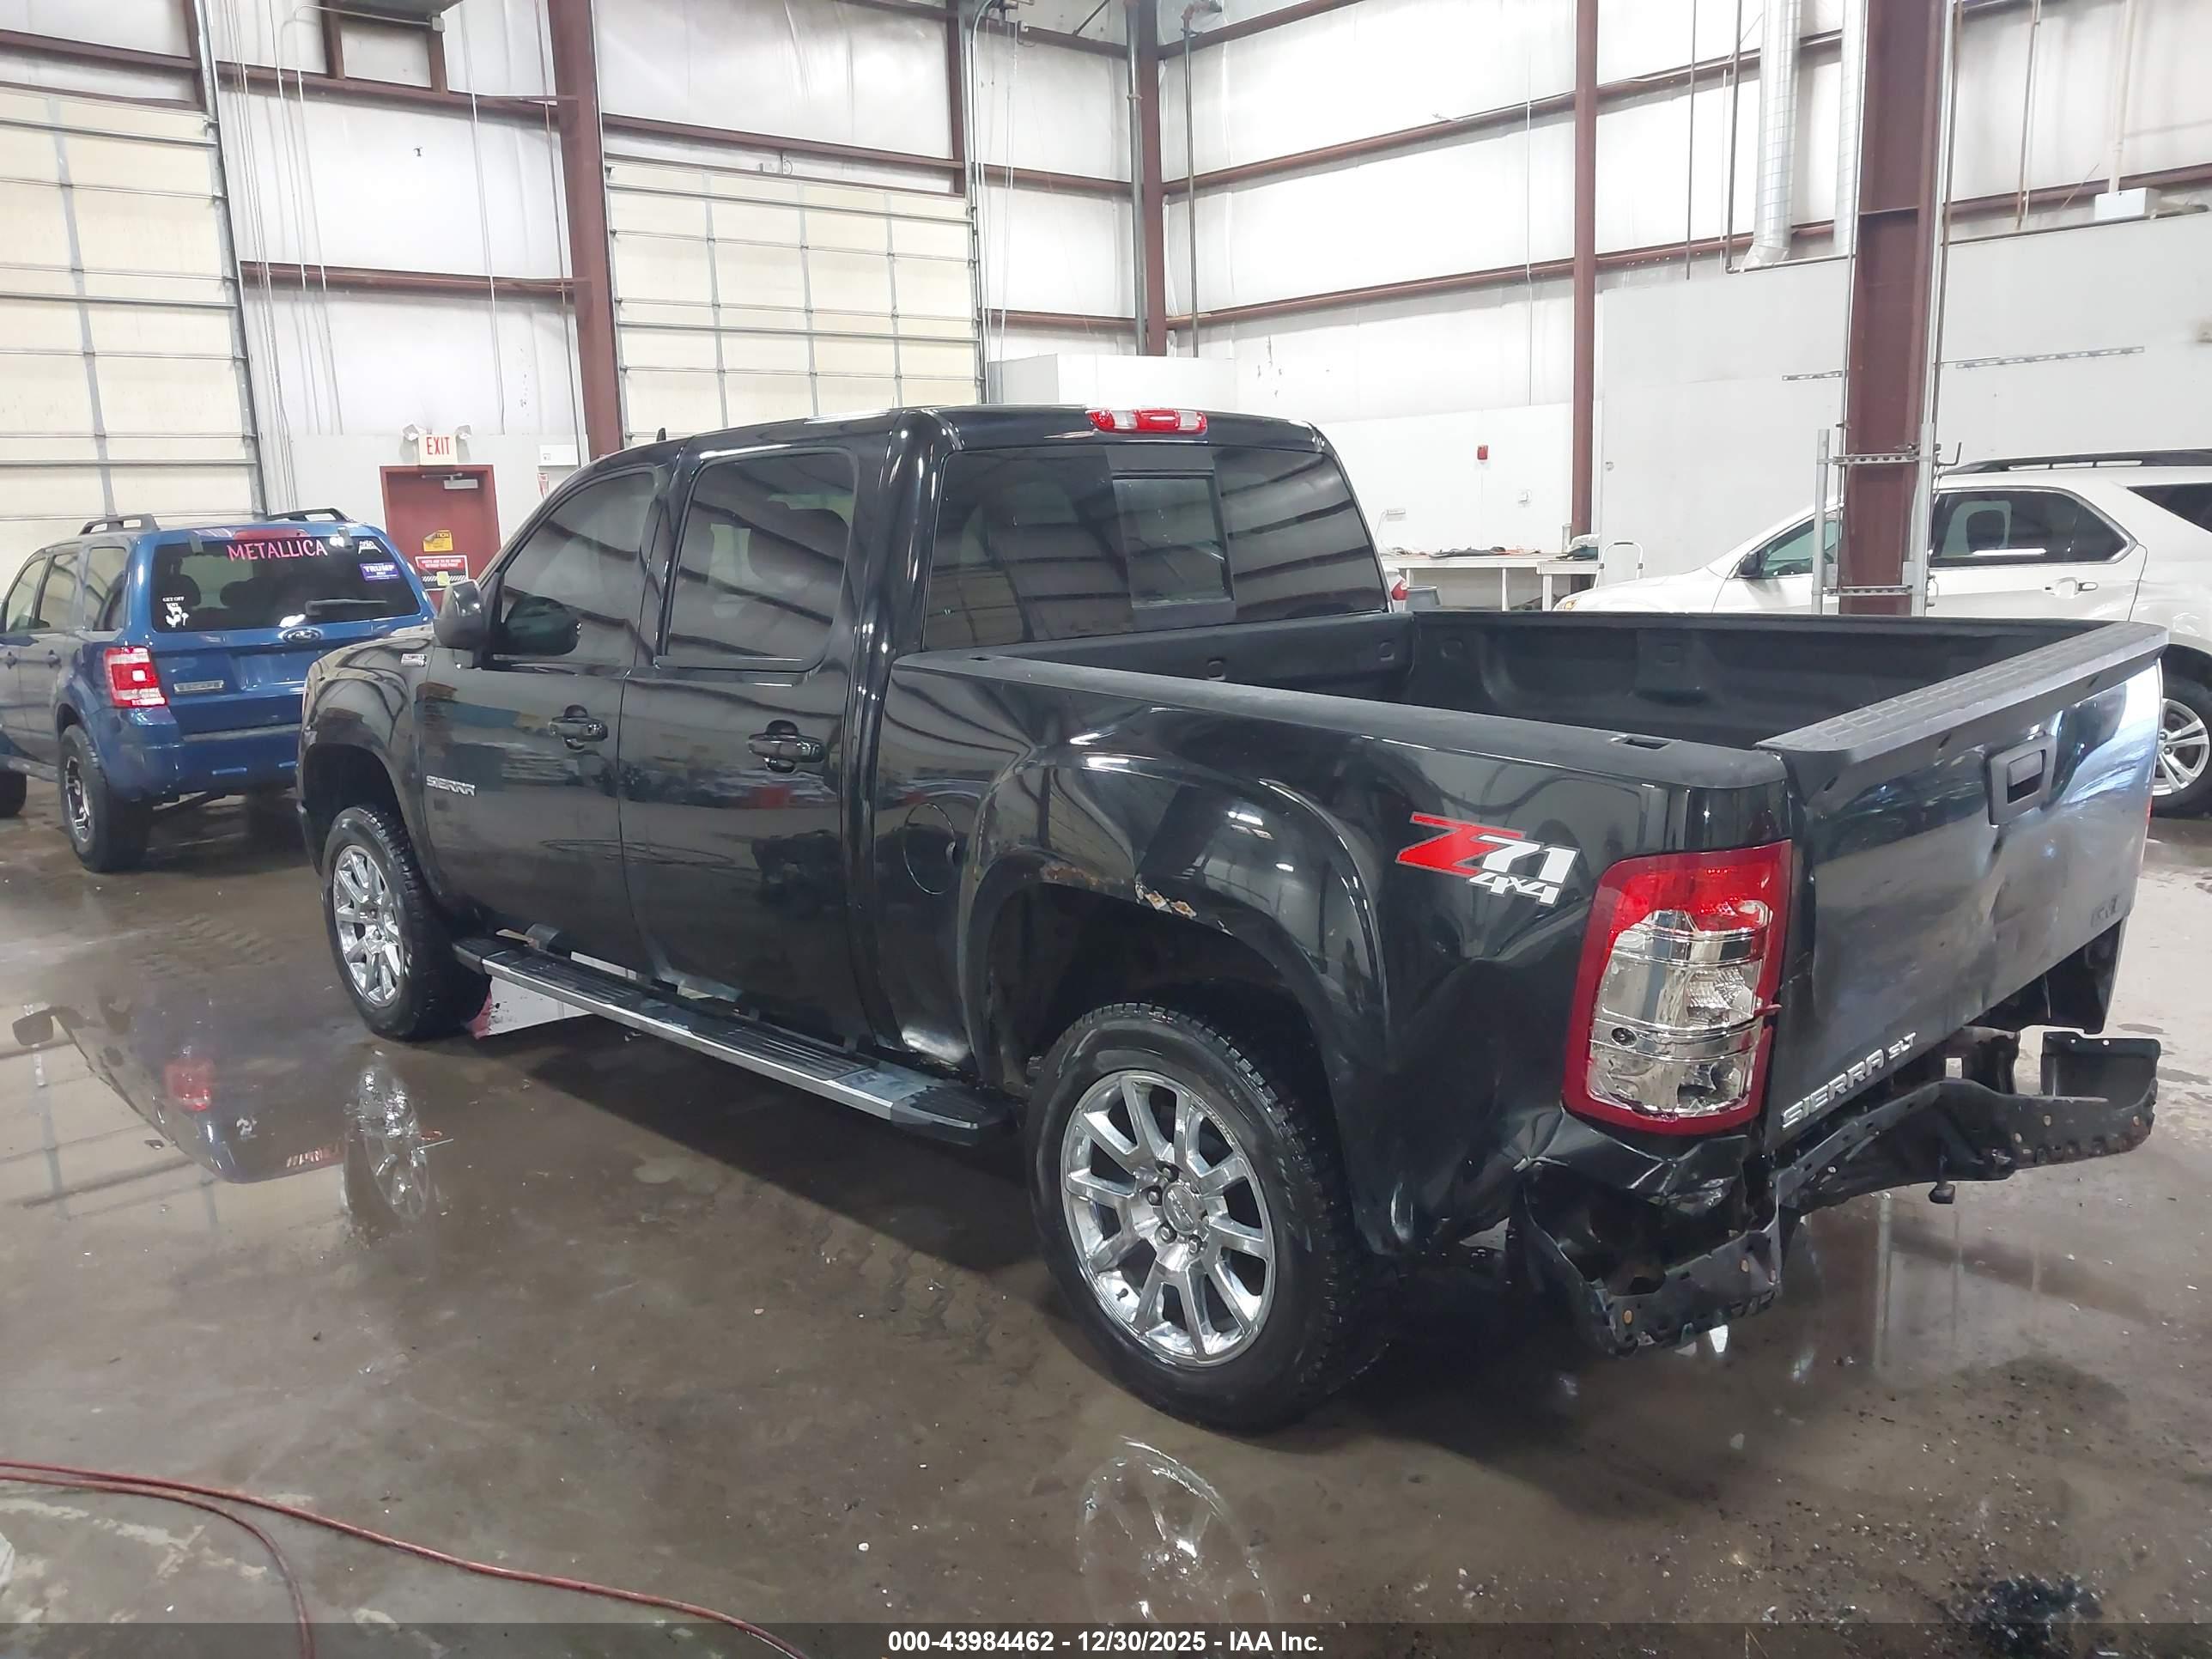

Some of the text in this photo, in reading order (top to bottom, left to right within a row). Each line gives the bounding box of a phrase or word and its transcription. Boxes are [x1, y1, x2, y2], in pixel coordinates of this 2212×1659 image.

[426, 436, 450, 455] EXIT
[227, 539, 328, 562] METALLICA
[362, 564, 395, 573] TRUMP
[426, 775, 476, 797] SIERRA
[1395, 811, 1580, 884] Z71
[1781, 1031, 1917, 1130] SIERRA SLT
